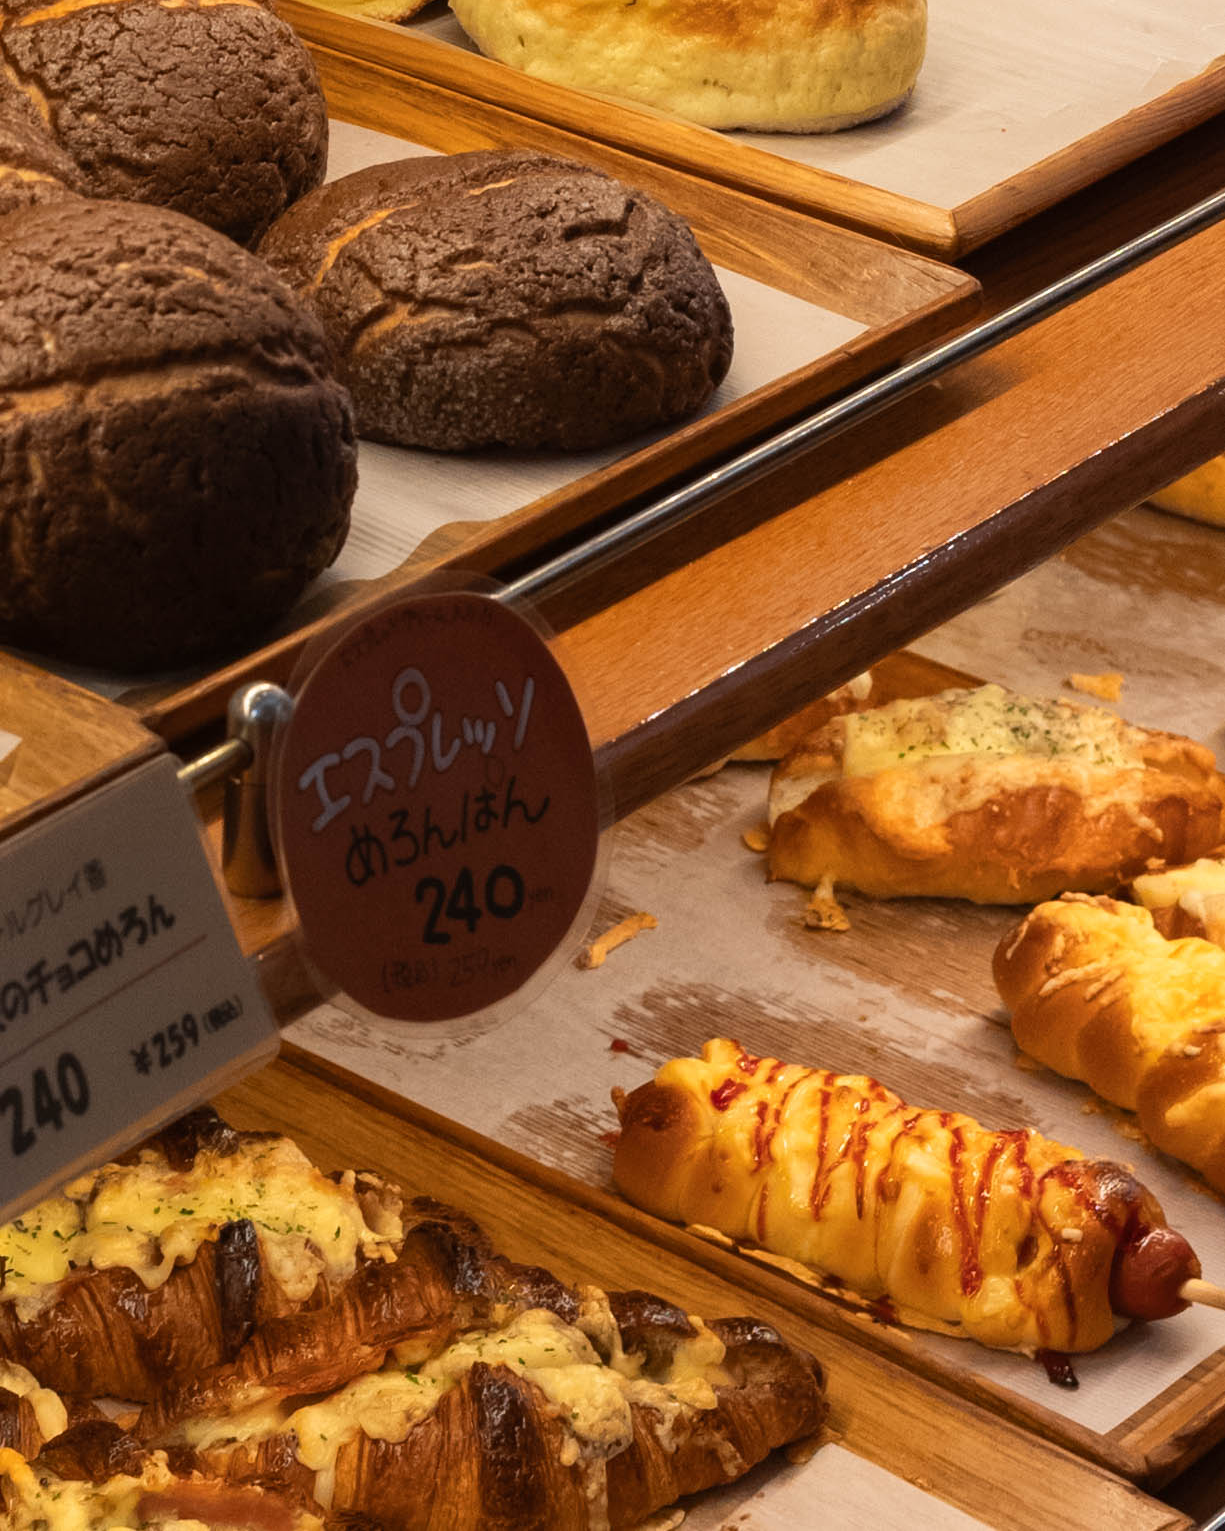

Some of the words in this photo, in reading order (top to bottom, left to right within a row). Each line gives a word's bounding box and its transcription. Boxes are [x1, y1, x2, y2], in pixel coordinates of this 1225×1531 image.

[299, 668, 535, 832] エスプレッソ
[416, 864, 526, 945] 240
[131, 1011, 200, 1075] ¥259
